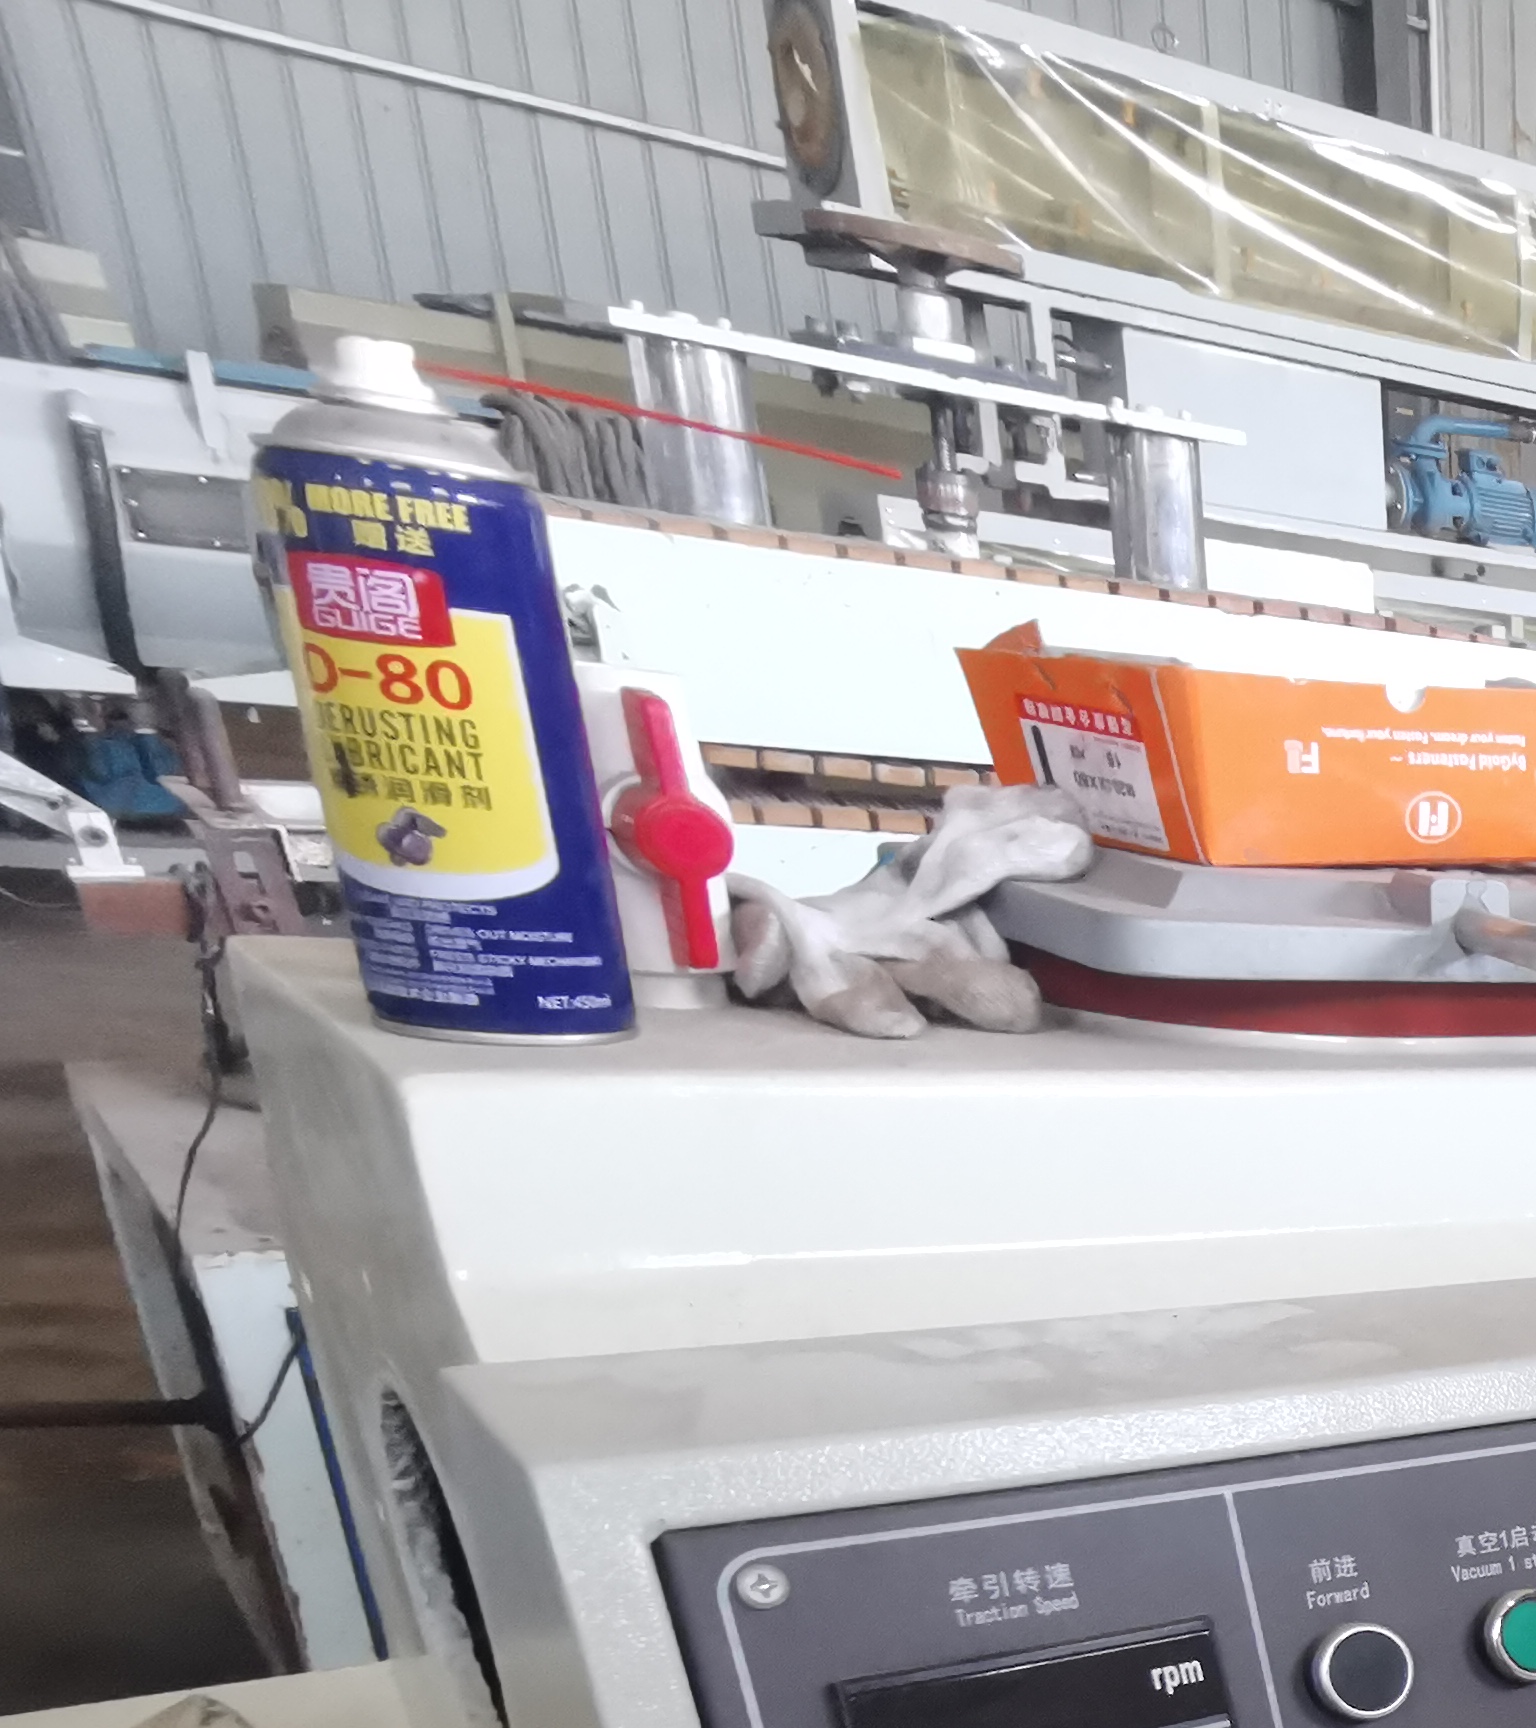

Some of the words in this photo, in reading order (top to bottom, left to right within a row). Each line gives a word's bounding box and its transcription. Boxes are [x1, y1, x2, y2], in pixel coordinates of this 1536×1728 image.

[304, 482, 394, 521] MORE
[395, 495, 472, 534] FREE
[306, 563, 420, 619] 贵阁
[314, 607, 422, 640] GUIGE
[948, 1562, 1075, 1605] 牵引转速
[1308, 1554, 1358, 1584] 前进
[1450, 1560, 1503, 1584] Vacuum
[1509, 1556, 1517, 1573] 1
[953, 1602, 1028, 1628] Traction
[1034, 1592, 1080, 1616] Speed
[1306, 1580, 1370, 1610] Forward
[1149, 1656, 1205, 1696] rpm
